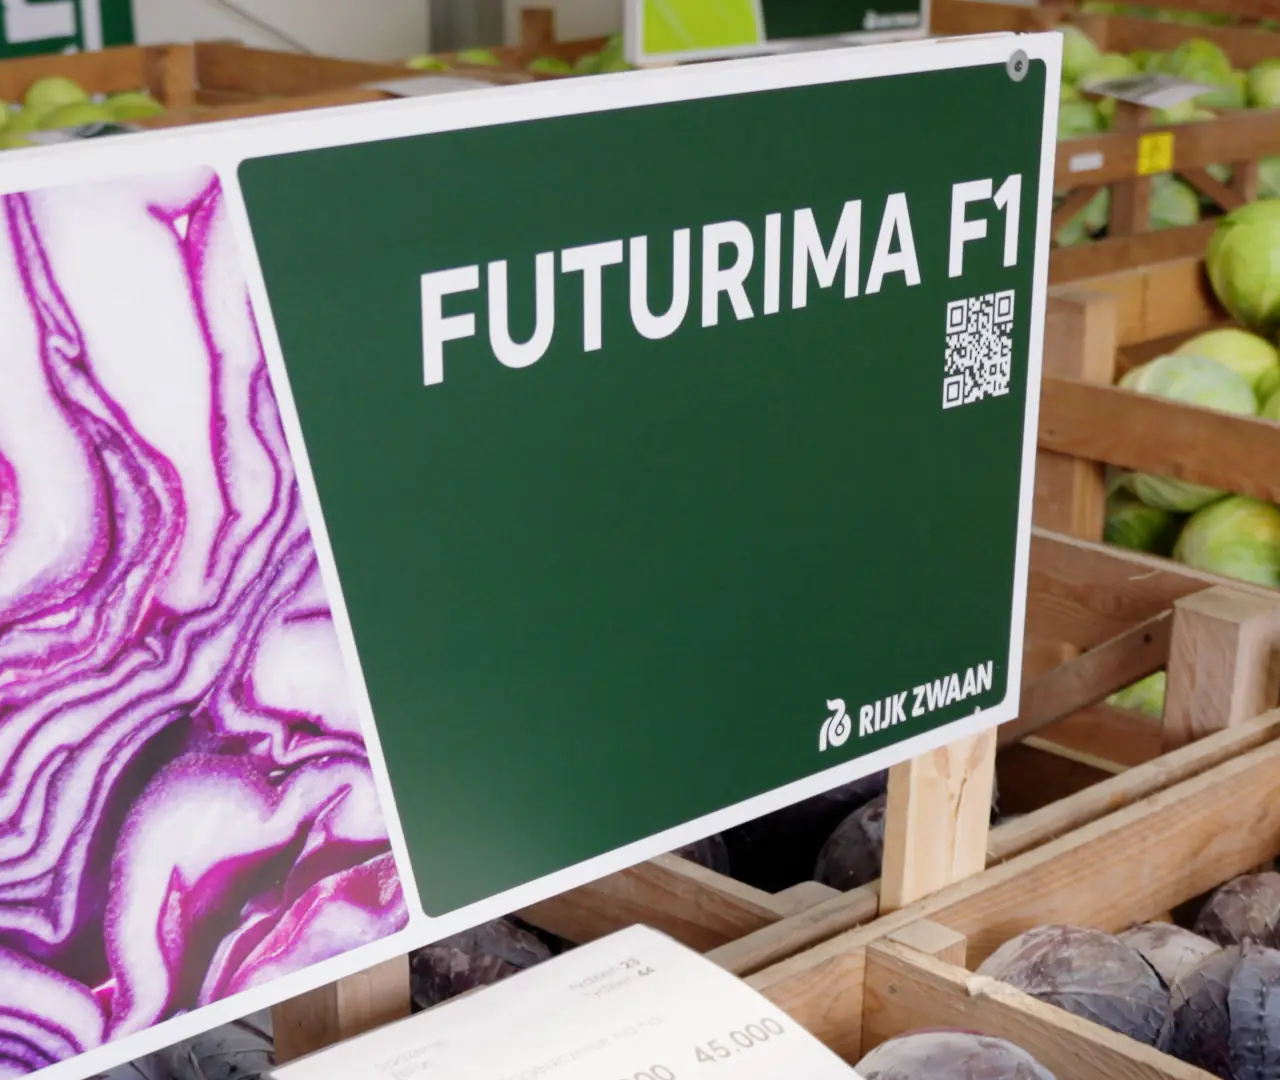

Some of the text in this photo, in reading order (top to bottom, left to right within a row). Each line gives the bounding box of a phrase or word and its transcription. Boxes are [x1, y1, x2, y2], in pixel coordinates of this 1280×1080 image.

[420, 173, 1022, 387] FUTURIMA F1
[858, 659, 994, 738] RIJK ZWAAN
[693, 1016, 786, 1065] 45.000
